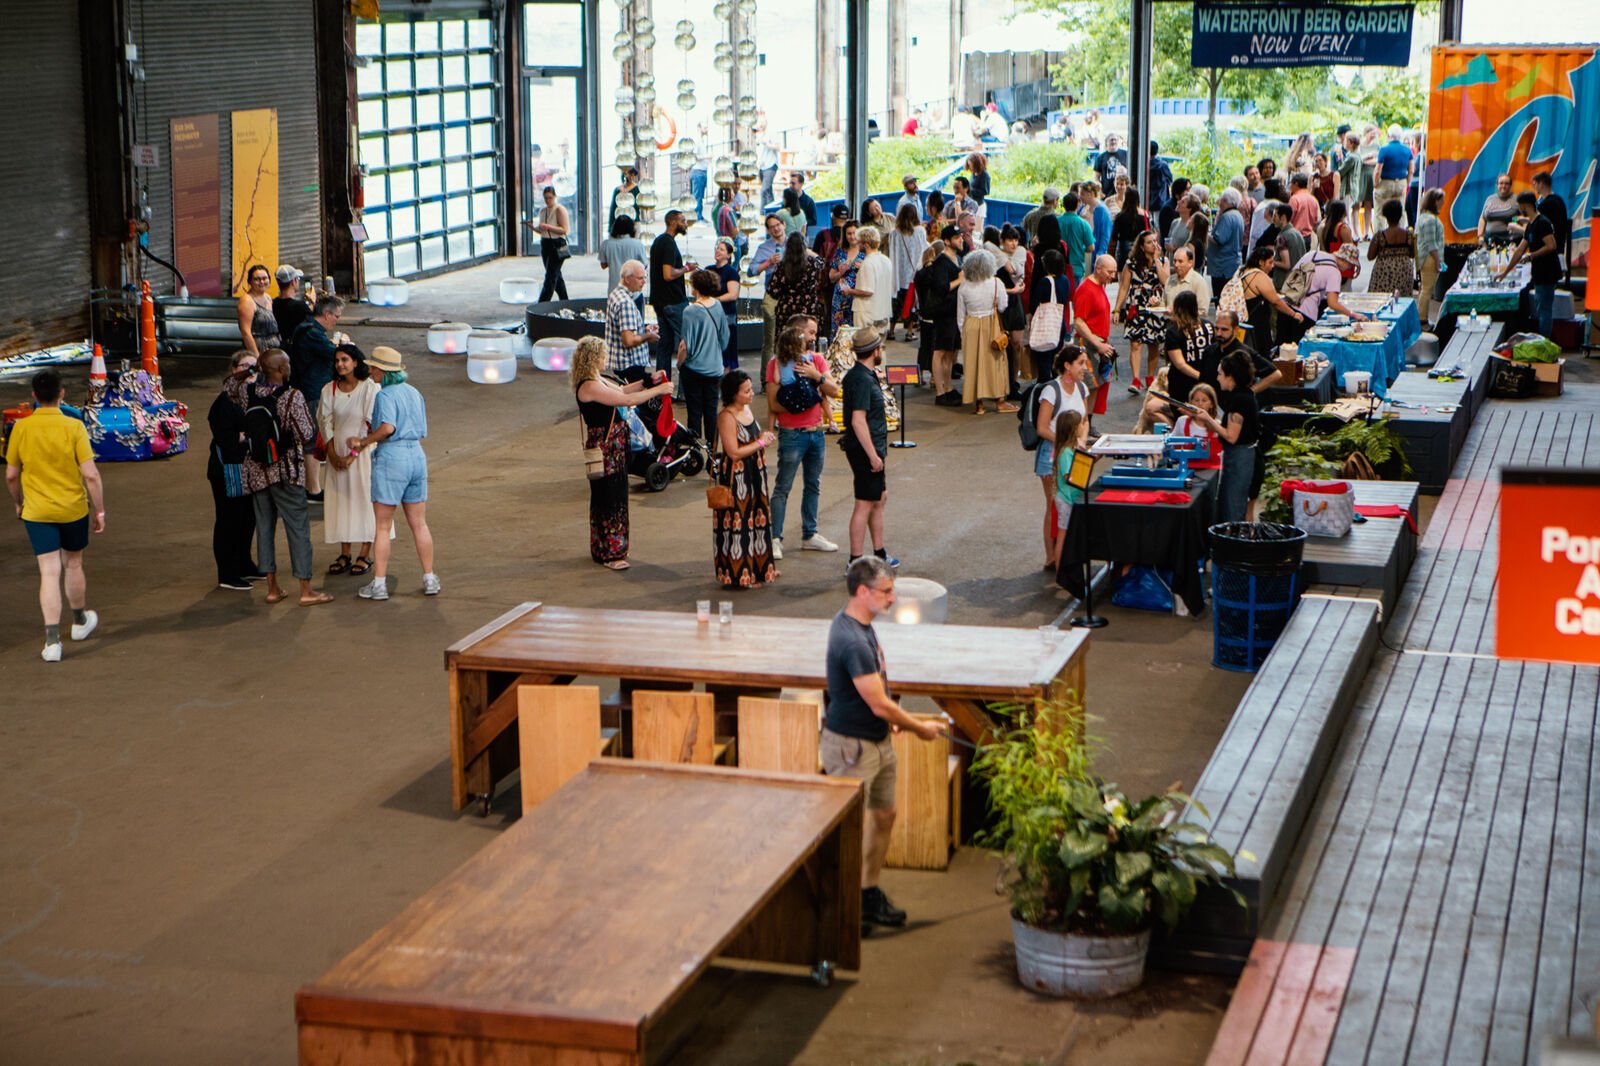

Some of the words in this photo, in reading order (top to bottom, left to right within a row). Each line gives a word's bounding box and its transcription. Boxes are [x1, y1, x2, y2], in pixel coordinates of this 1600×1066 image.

[1198, 8, 1300, 33] WATERFRONT
[1303, 8, 1341, 33] BEER
[1345, 8, 1409, 33] GARDEN
[1250, 33, 1293, 55] NOW
[1299, 34, 1355, 55] OPEN!
